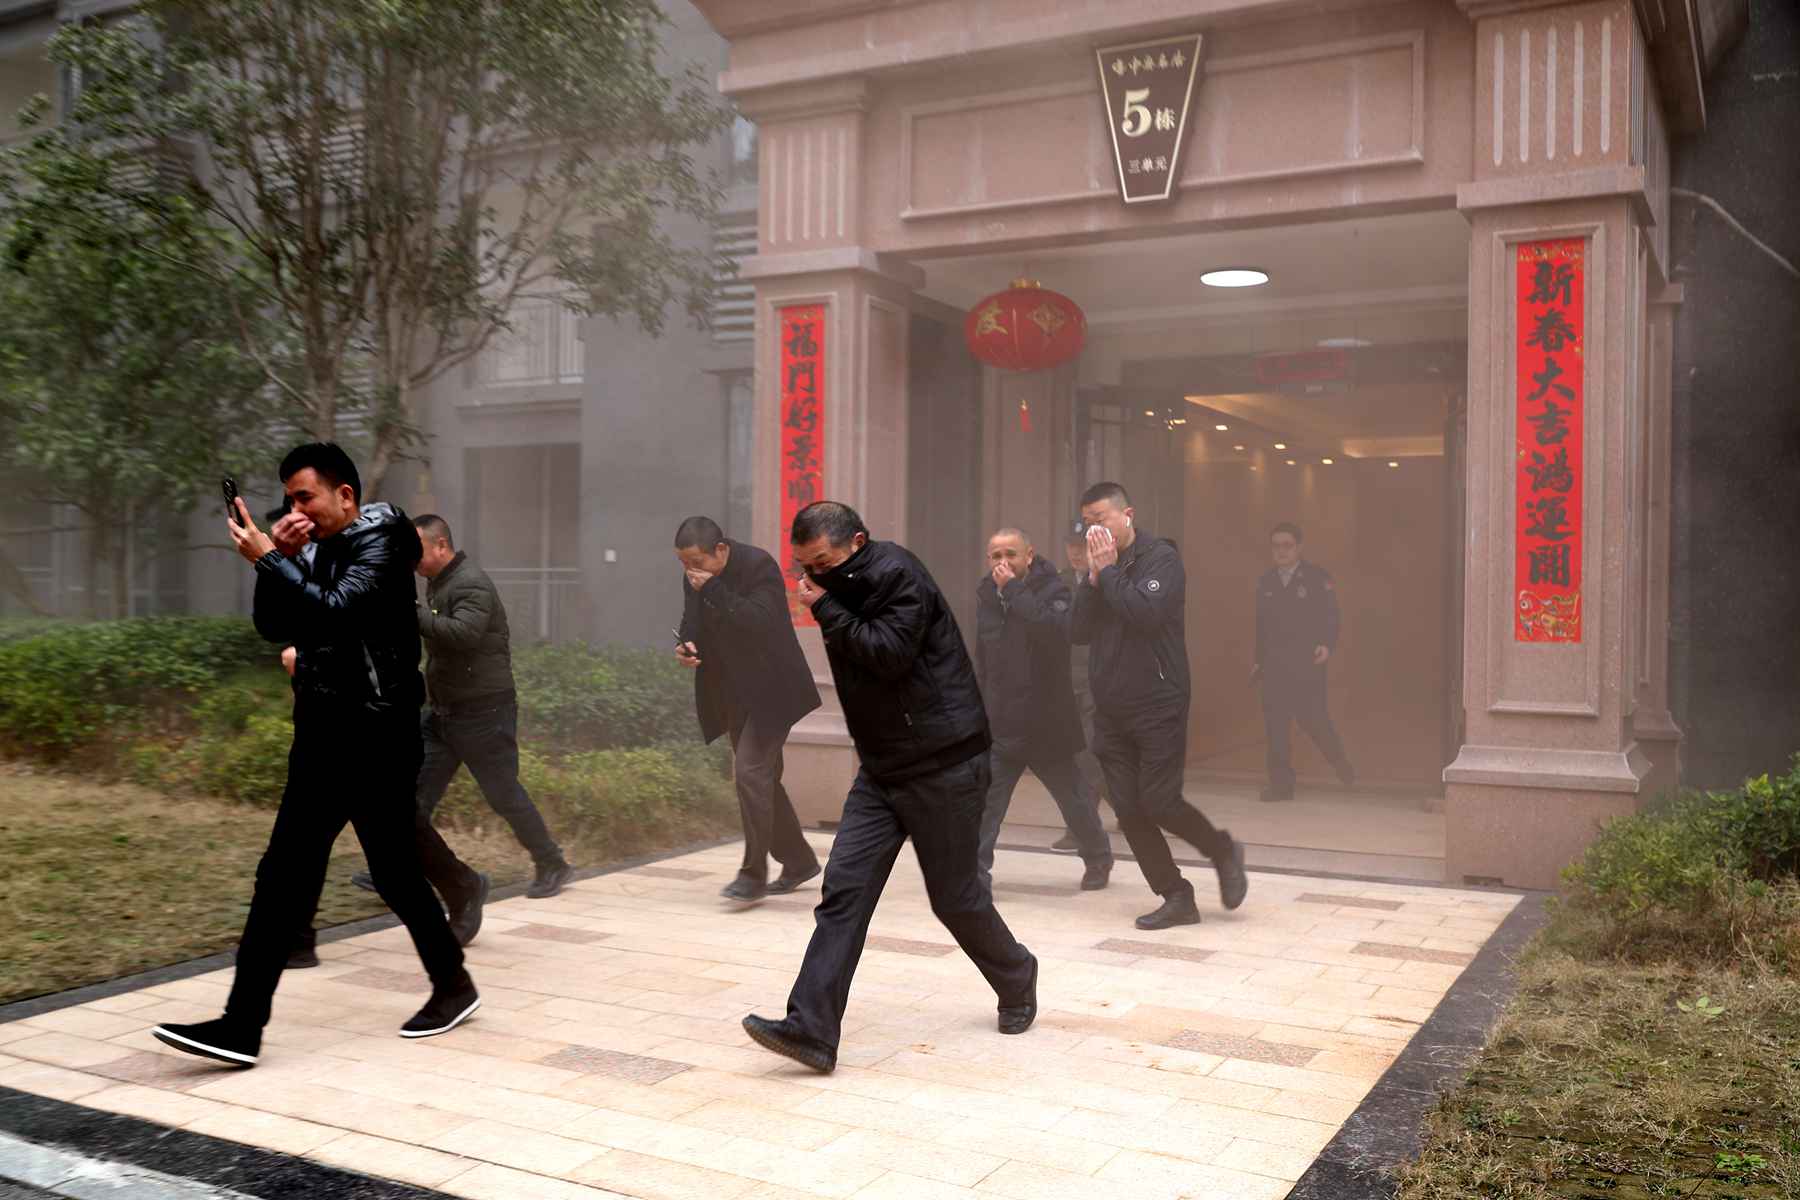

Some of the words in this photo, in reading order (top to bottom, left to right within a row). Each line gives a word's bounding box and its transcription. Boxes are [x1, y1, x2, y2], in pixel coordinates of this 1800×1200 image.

[1122, 88, 1176, 137] 5栋
[1525, 261, 1576, 588] 新春大吉鴻運開
